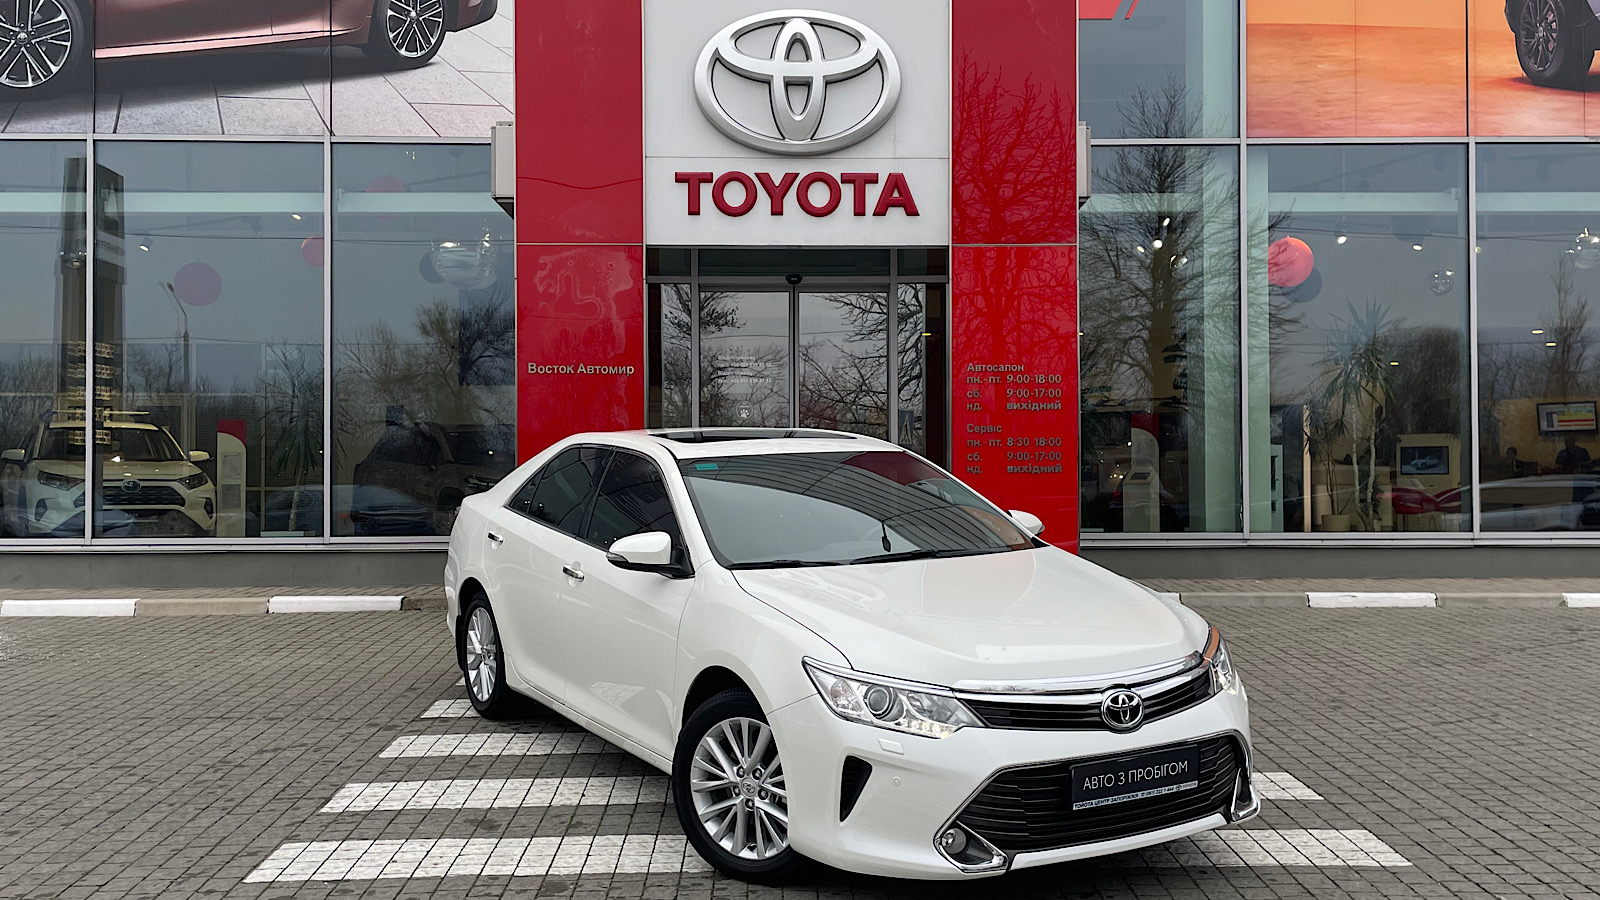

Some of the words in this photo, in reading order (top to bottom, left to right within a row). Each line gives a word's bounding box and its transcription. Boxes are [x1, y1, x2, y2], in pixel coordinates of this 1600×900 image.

[675, 171, 920, 217] TOYOTA
[528, 363, 574, 374] Восток
[577, 363, 635, 377] Автомир
[967, 363, 1024, 372] Автосалон
[966, 388, 983, 398] сб.
[966, 403, 983, 412] нд.
[1006, 400, 1062, 412] вихідний
[966, 423, 1003, 435] Сервіс
[966, 452, 984, 462] сб.
[966, 466, 984, 475] нд.
[1006, 463, 1063, 475] вихідний
[1083, 773, 1115, 790] АВТО
[1117, 771, 1126, 785] З
[1128, 760, 1188, 783] ПРОБІГОМ
